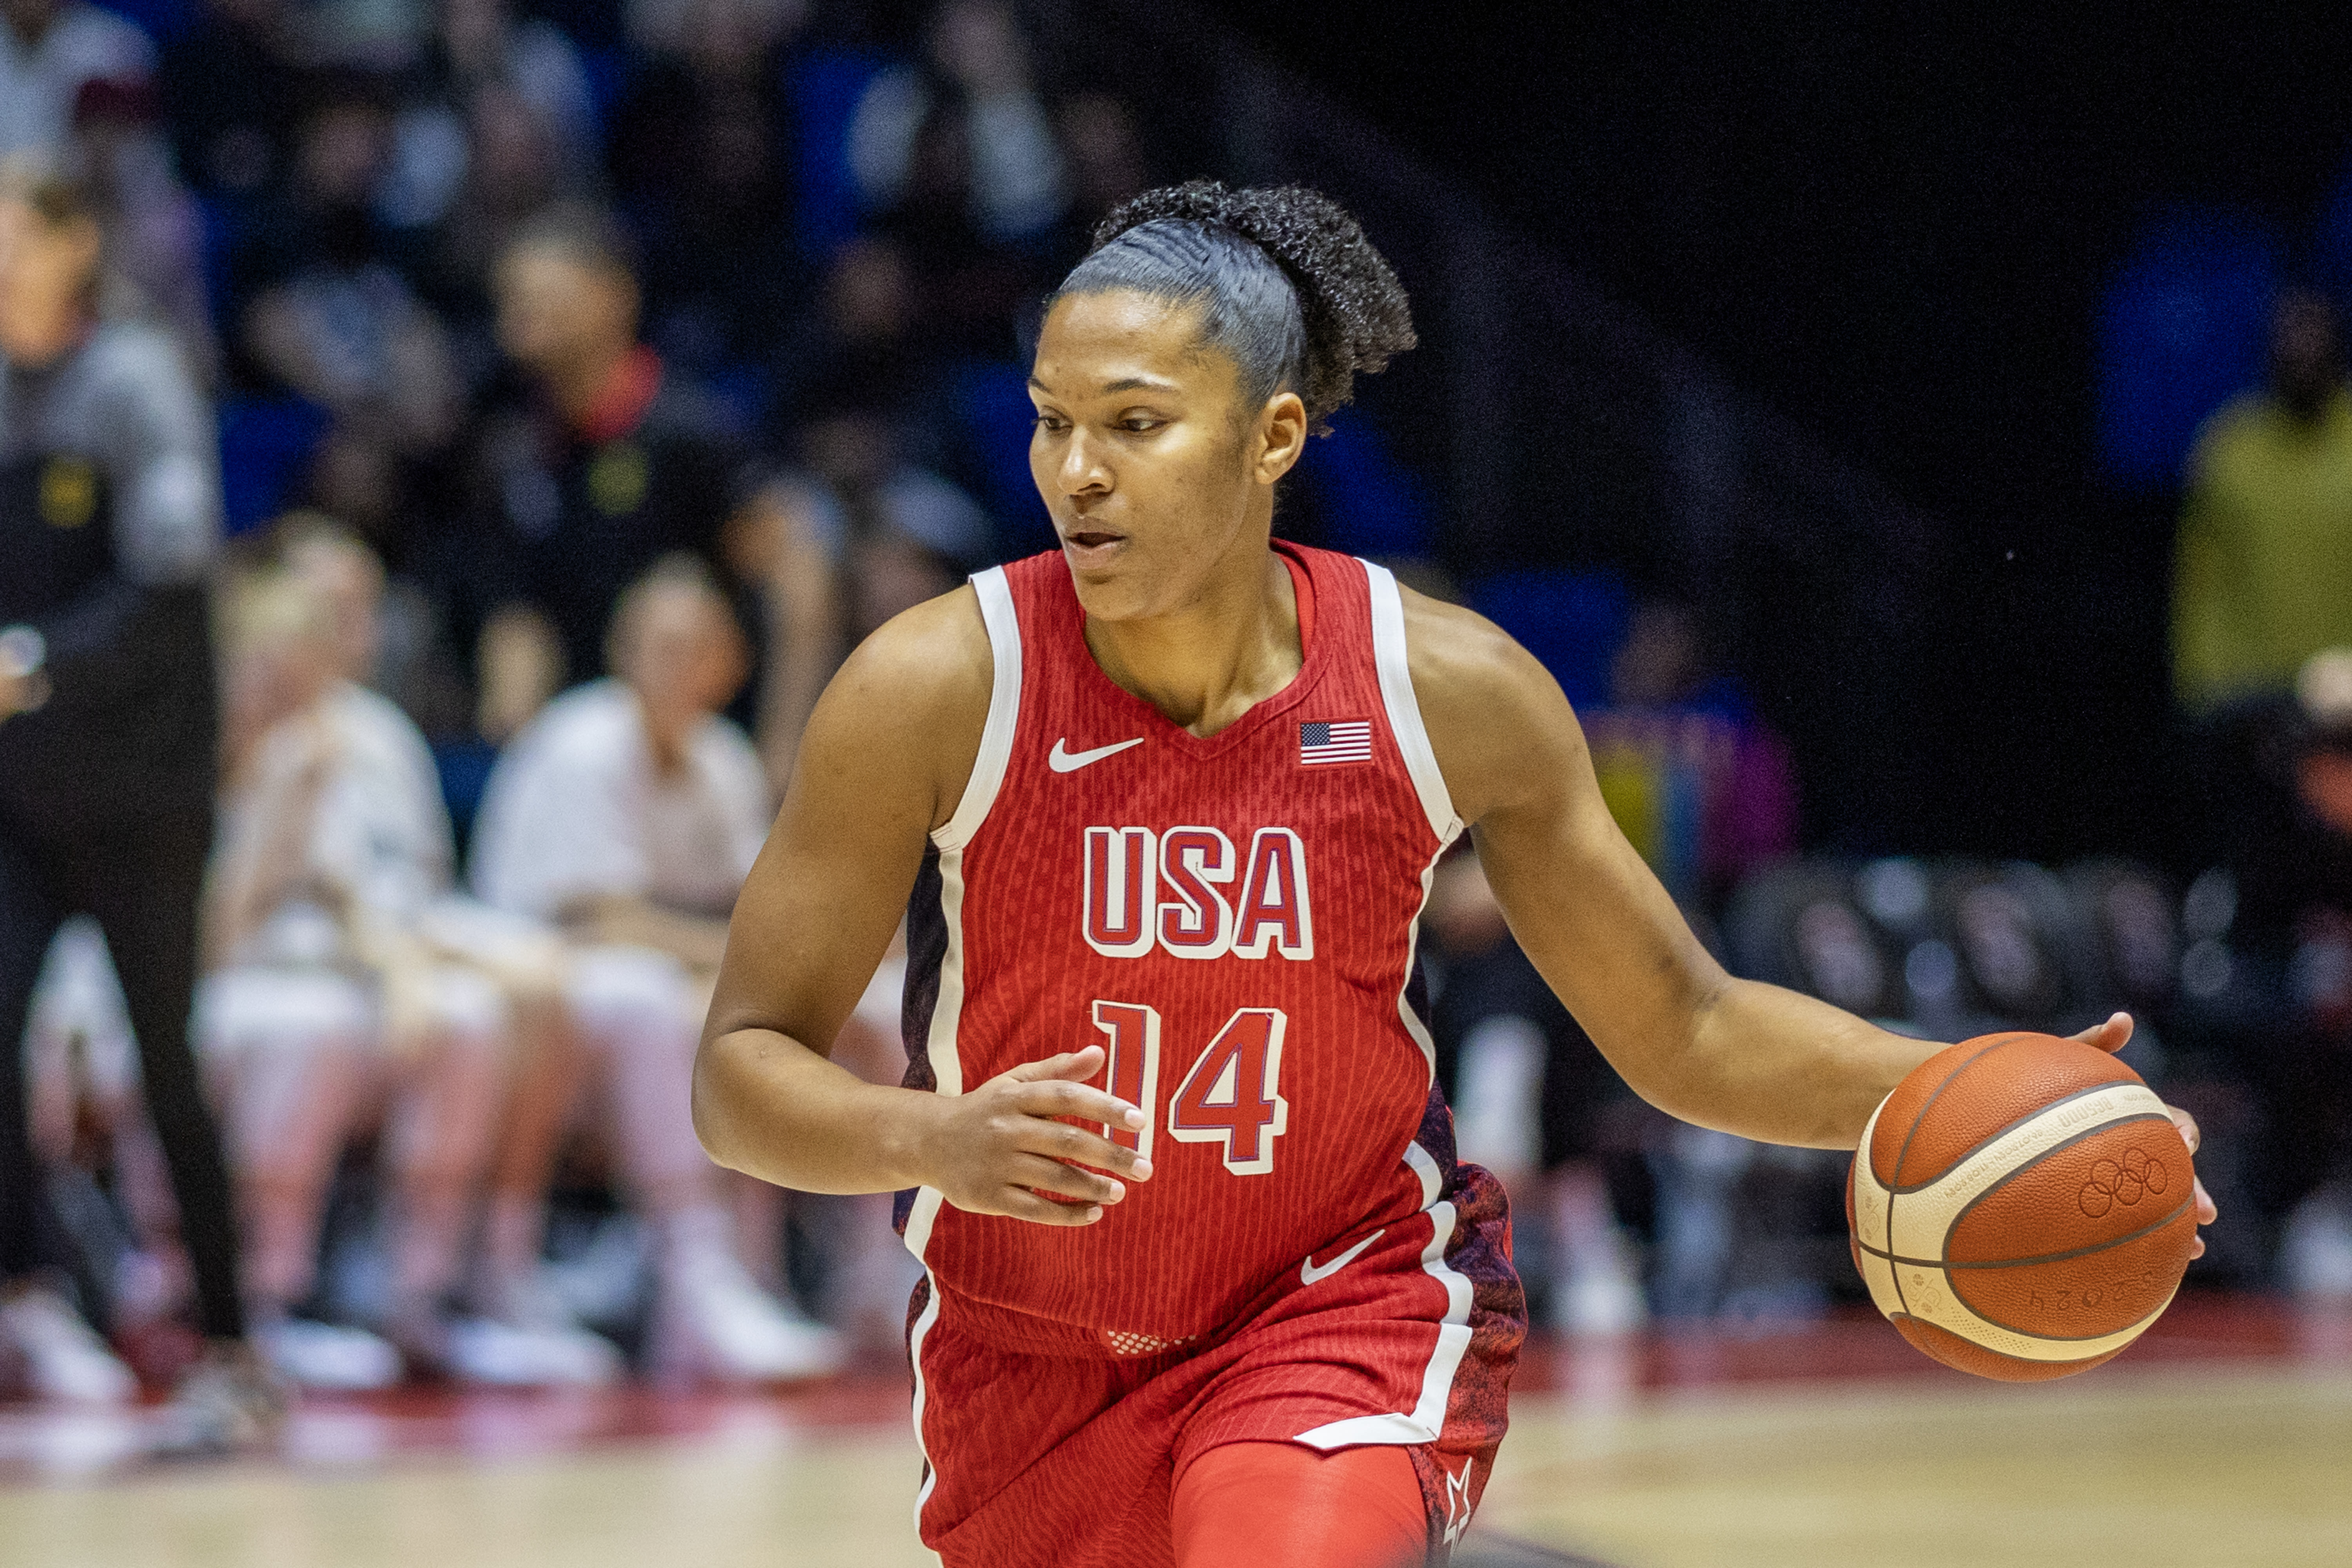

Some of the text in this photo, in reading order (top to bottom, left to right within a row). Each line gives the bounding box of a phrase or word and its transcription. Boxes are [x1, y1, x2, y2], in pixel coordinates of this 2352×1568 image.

[1082, 826, 1314, 960] USA
[1092, 1000, 1289, 1176] 14
[2057, 1096, 2114, 1127] BG5000
[1994, 1130, 2043, 1161] 26.07.2024
